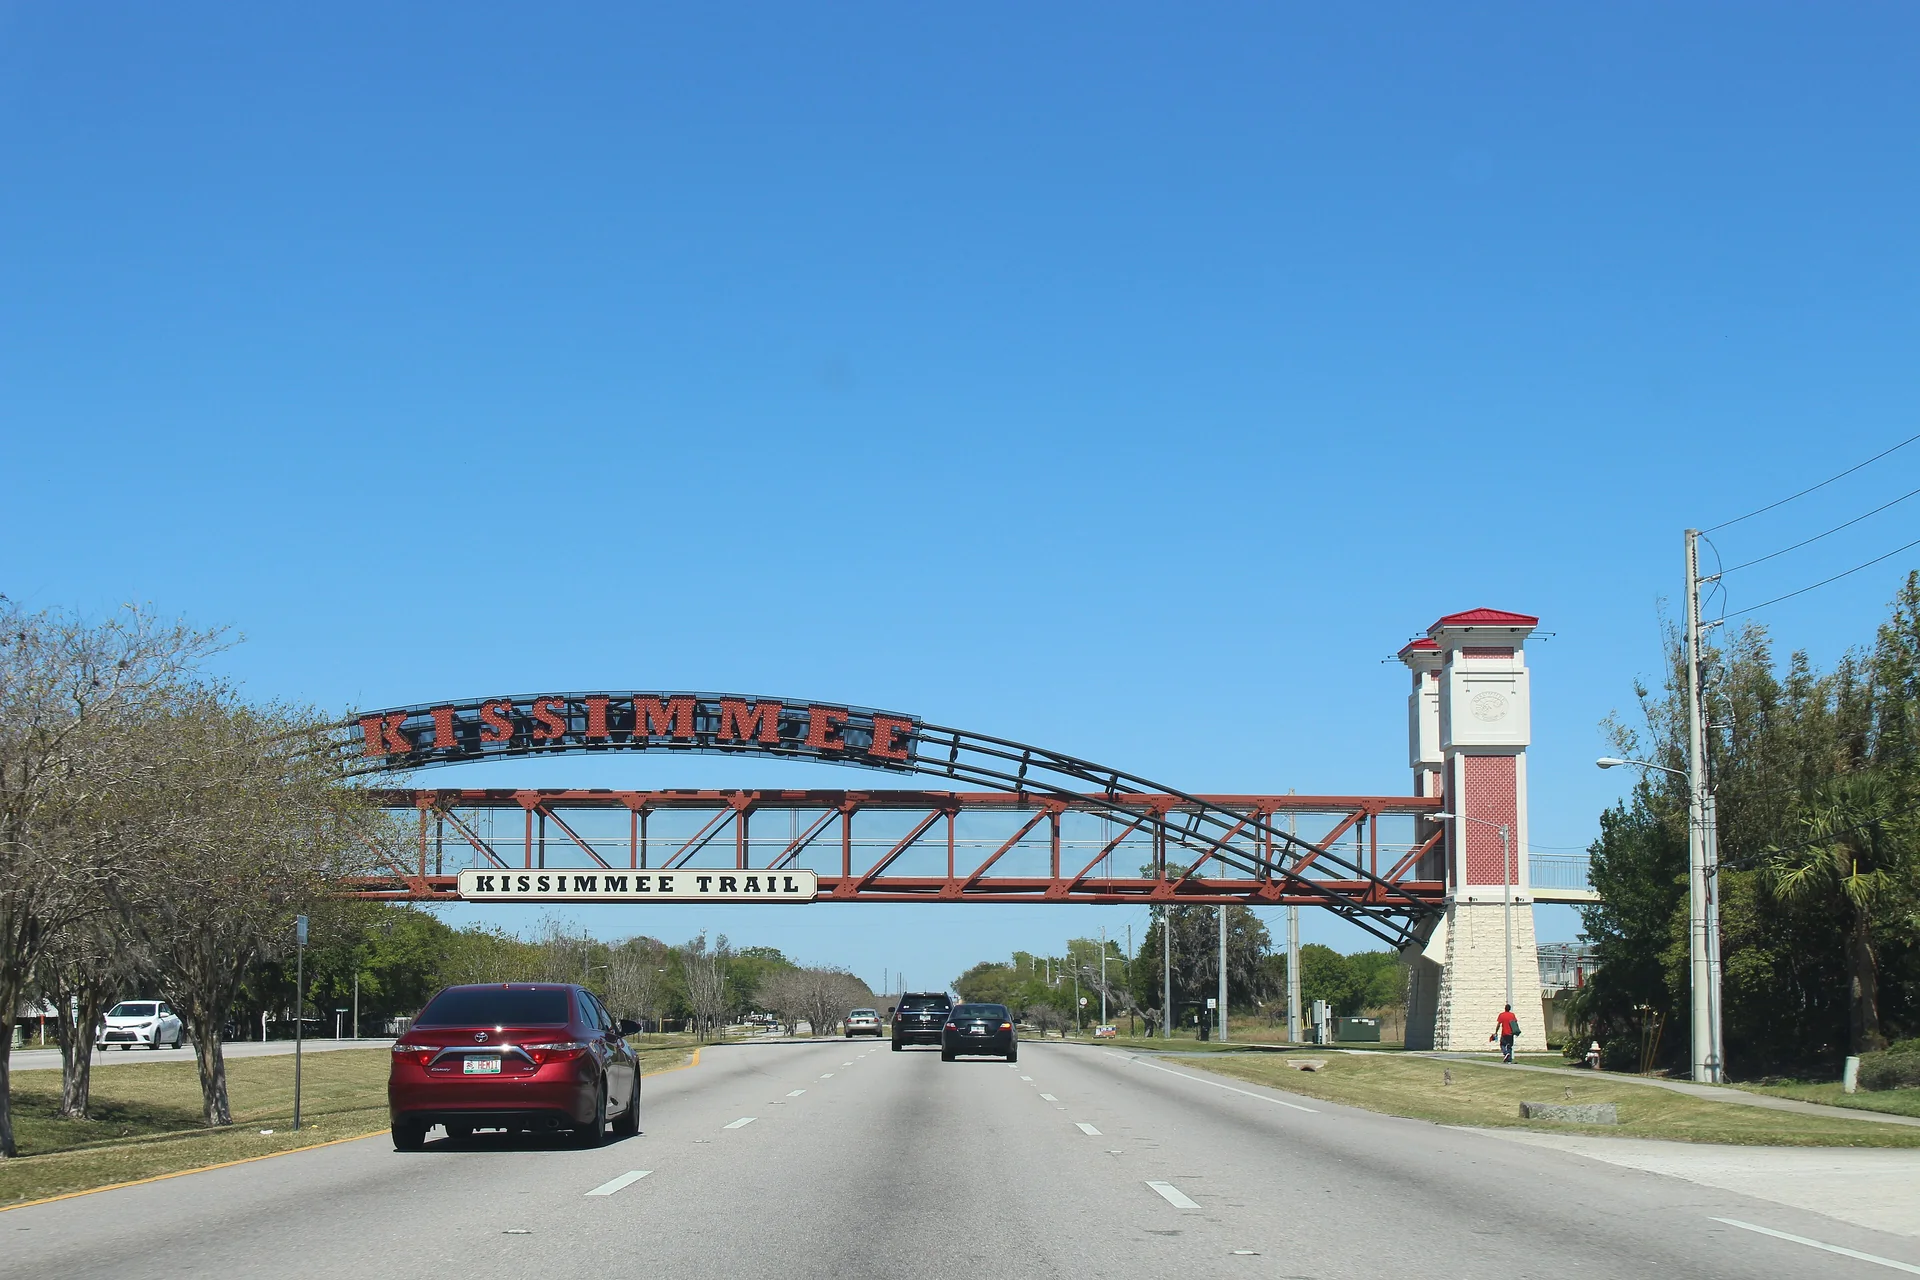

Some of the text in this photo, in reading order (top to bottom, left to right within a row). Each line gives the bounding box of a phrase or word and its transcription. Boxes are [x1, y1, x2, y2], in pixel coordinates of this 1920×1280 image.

[359, 694, 913, 760] KISSIMMEE
[476, 875, 799, 893] KISSIMMEE TRAIL
